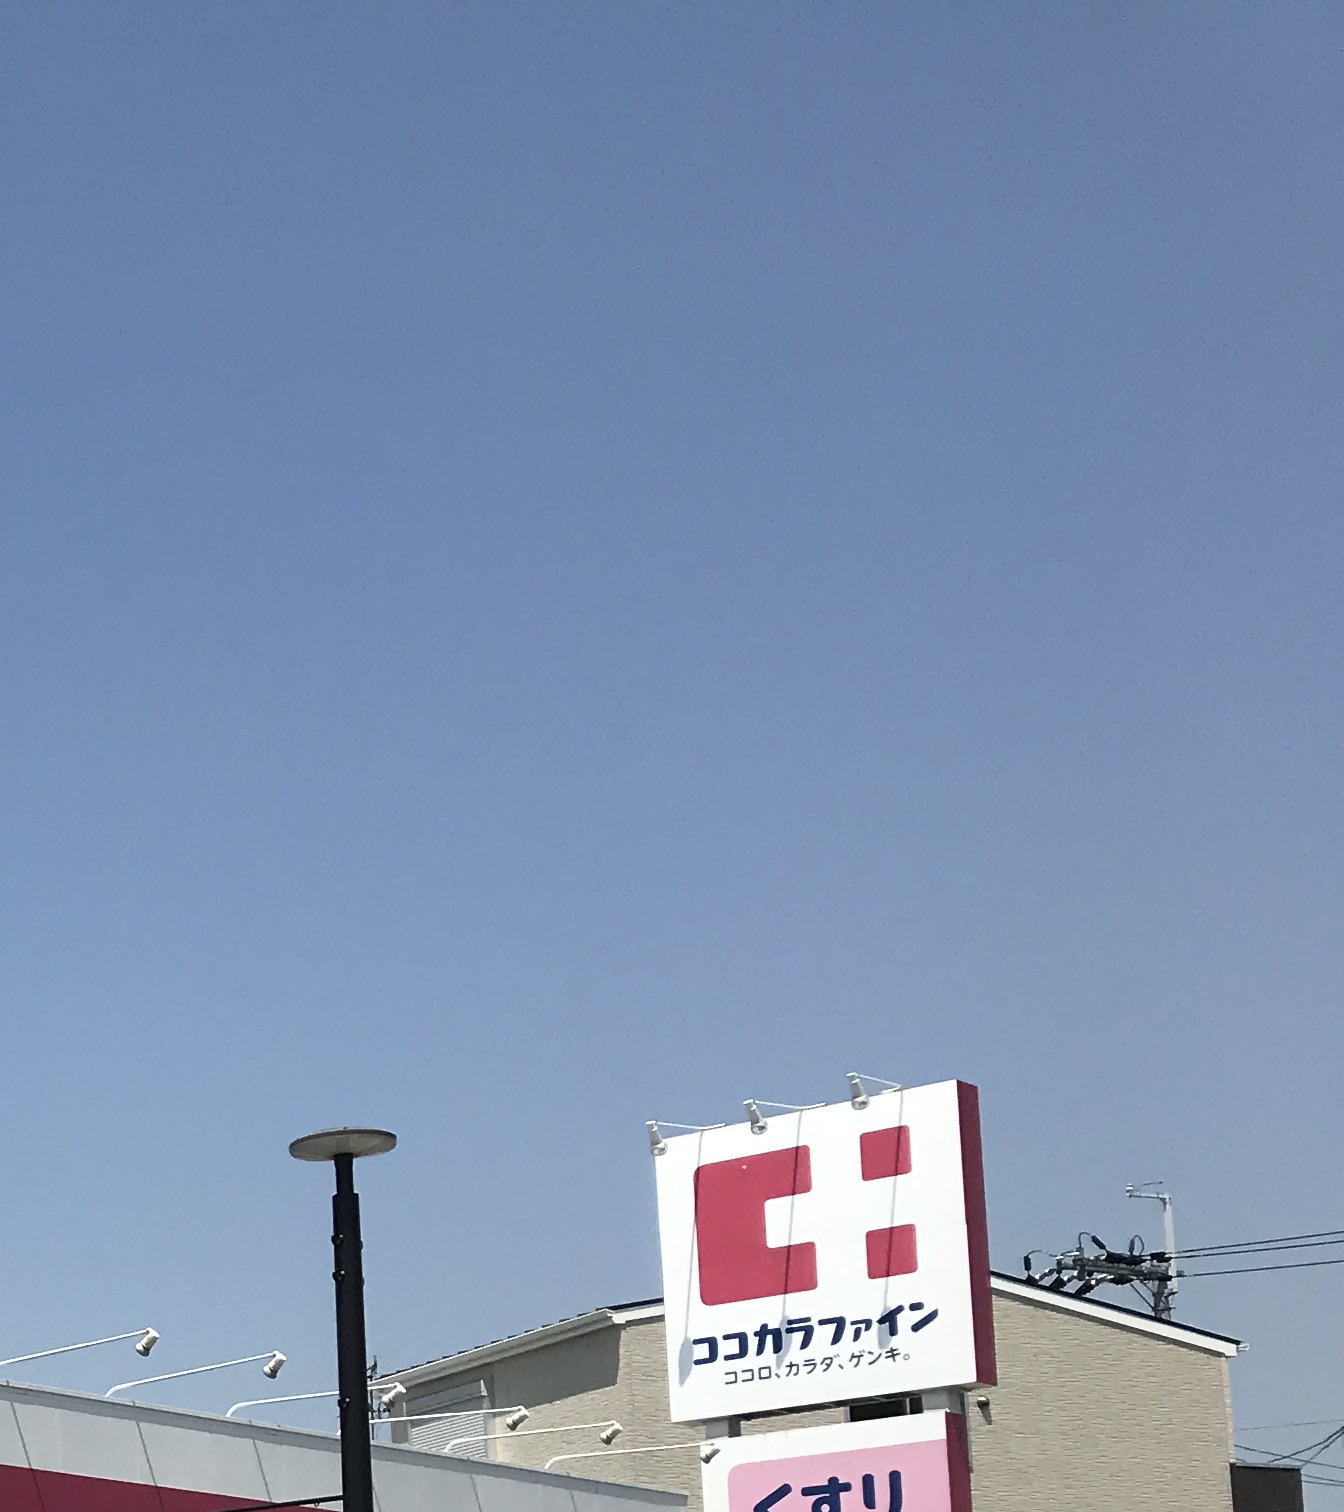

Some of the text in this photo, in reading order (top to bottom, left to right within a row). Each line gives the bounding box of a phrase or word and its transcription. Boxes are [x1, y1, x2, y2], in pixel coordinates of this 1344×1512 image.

[692, 1301, 939, 1366] ココカラファイン
[725, 1347, 910, 1386] ココロ、カラダ、ゲンキ。
